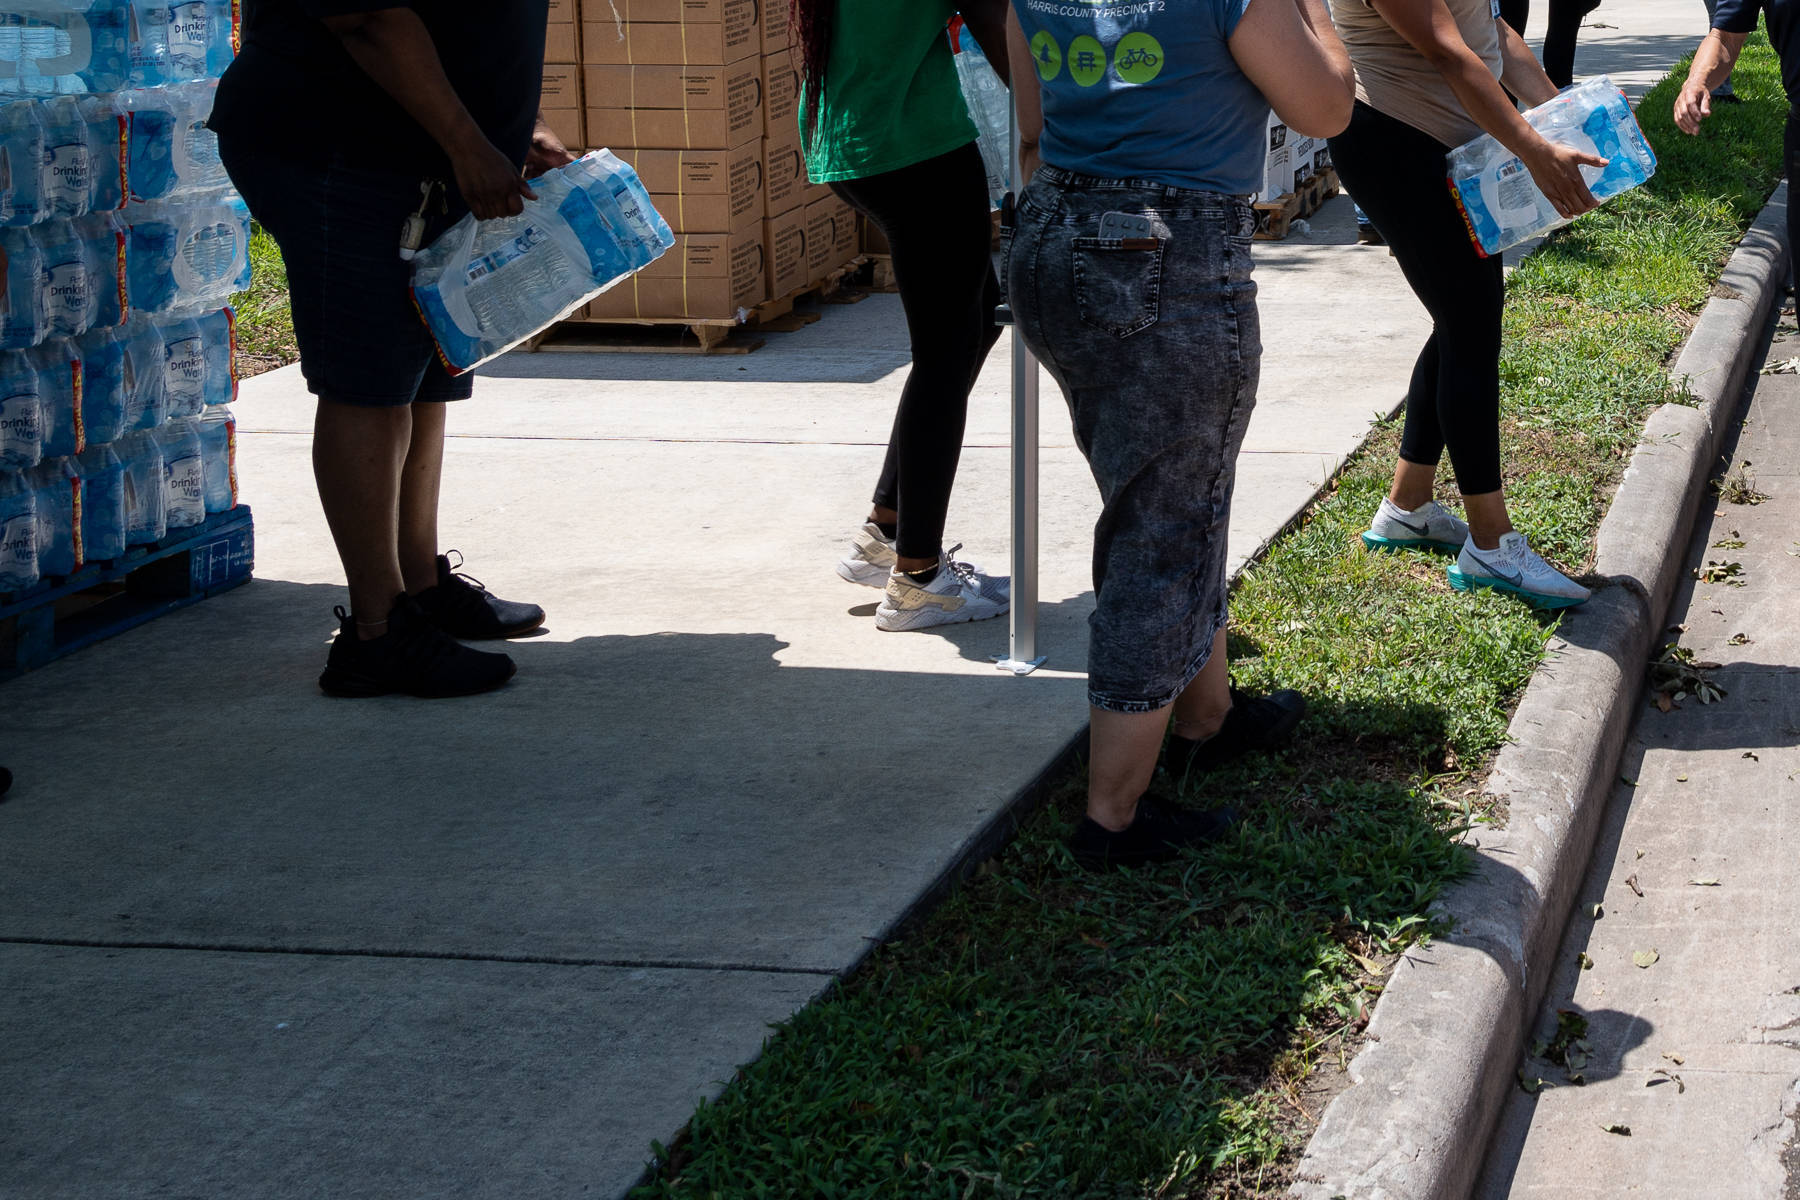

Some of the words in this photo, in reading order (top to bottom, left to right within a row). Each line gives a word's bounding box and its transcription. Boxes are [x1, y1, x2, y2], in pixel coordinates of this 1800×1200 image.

[1027, 0, 1058, 15] HARRIS
[1060, 5, 1102, 18] COUNTY
[1104, 1, 1155, 17] PRECINCT
[1158, 1, 1165, 11] 2
